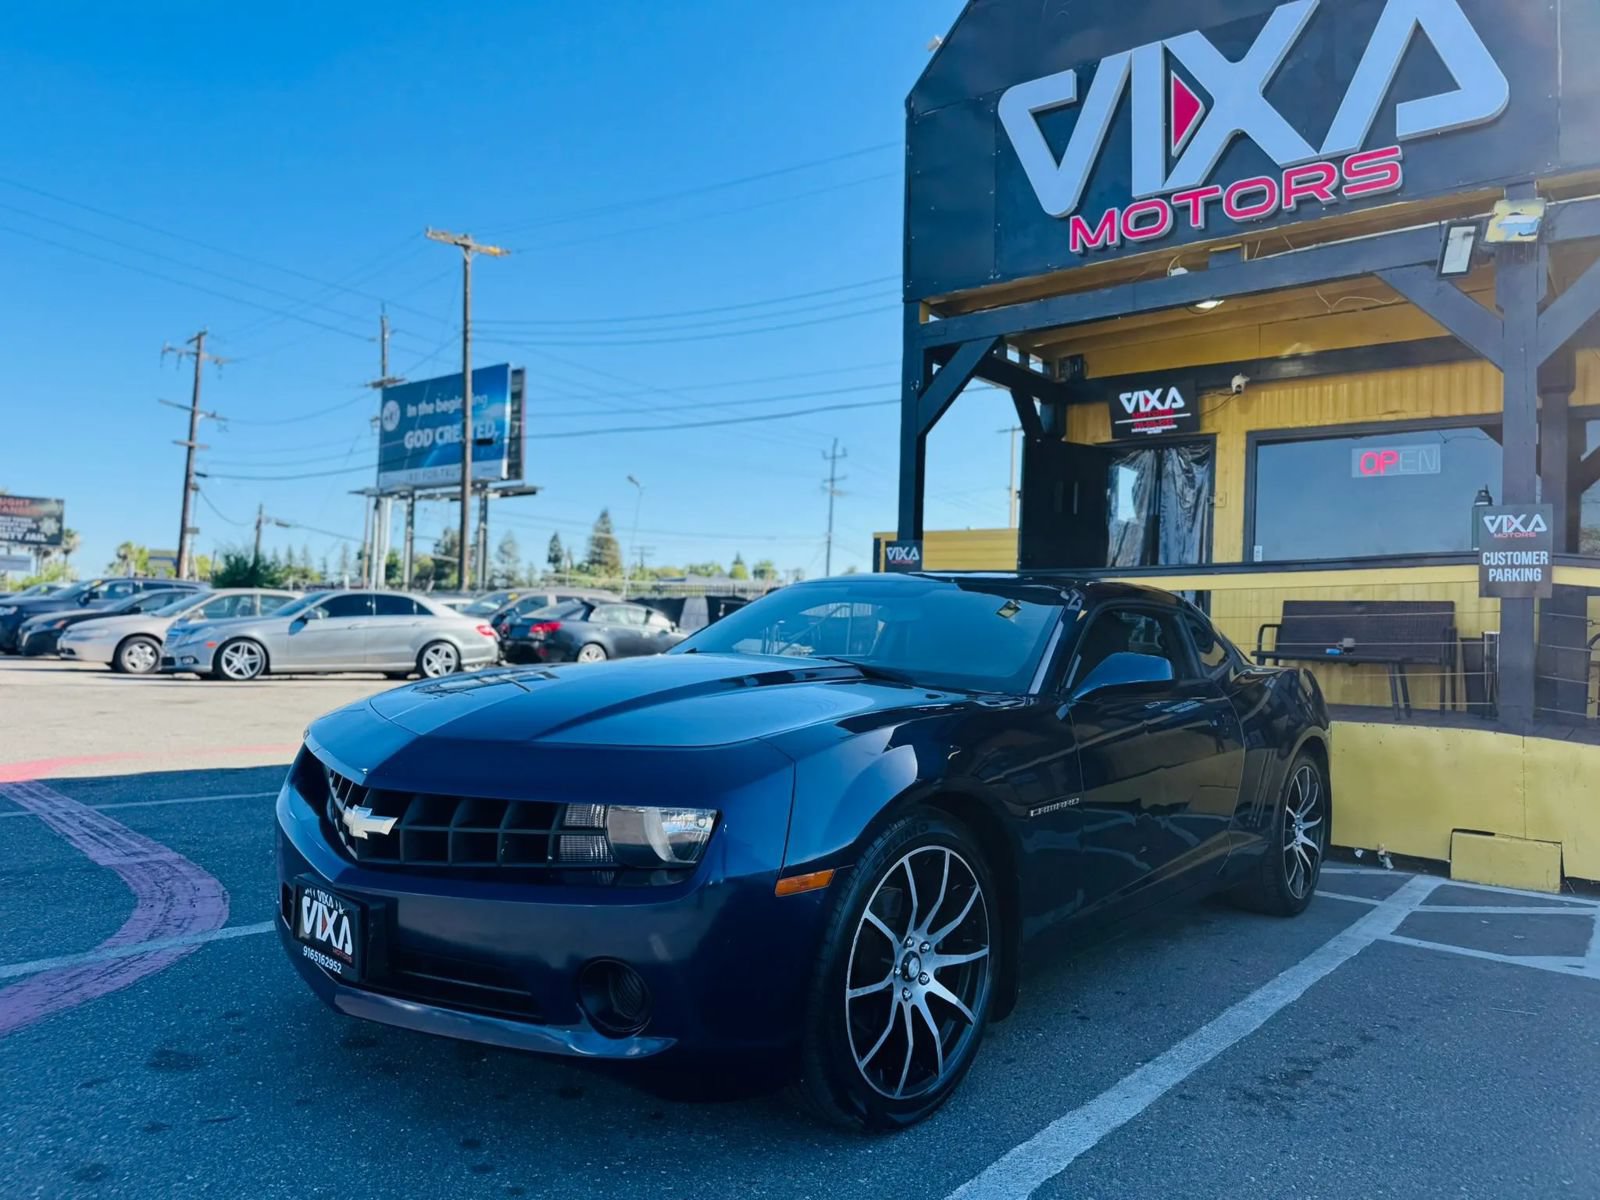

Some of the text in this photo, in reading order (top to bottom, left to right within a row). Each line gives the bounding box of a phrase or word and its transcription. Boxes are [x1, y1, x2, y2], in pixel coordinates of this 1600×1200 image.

[998, 0, 1510, 217] VIXA
[1070, 146, 1403, 253] MOTORS
[435, 393, 488, 414] begining
[1119, 386, 1185, 414] VIXA
[404, 428, 433, 449] GOD
[1360, 447, 1437, 475] OPEN
[1483, 513, 1547, 534] VIXA
[887, 546, 920, 561] VIXA
[1482, 551, 1548, 567] CUSTOMER
[1489, 567, 1541, 583] PARKING
[302, 895, 353, 956] VIXA
[303, 946, 342, 974] 9165162952
